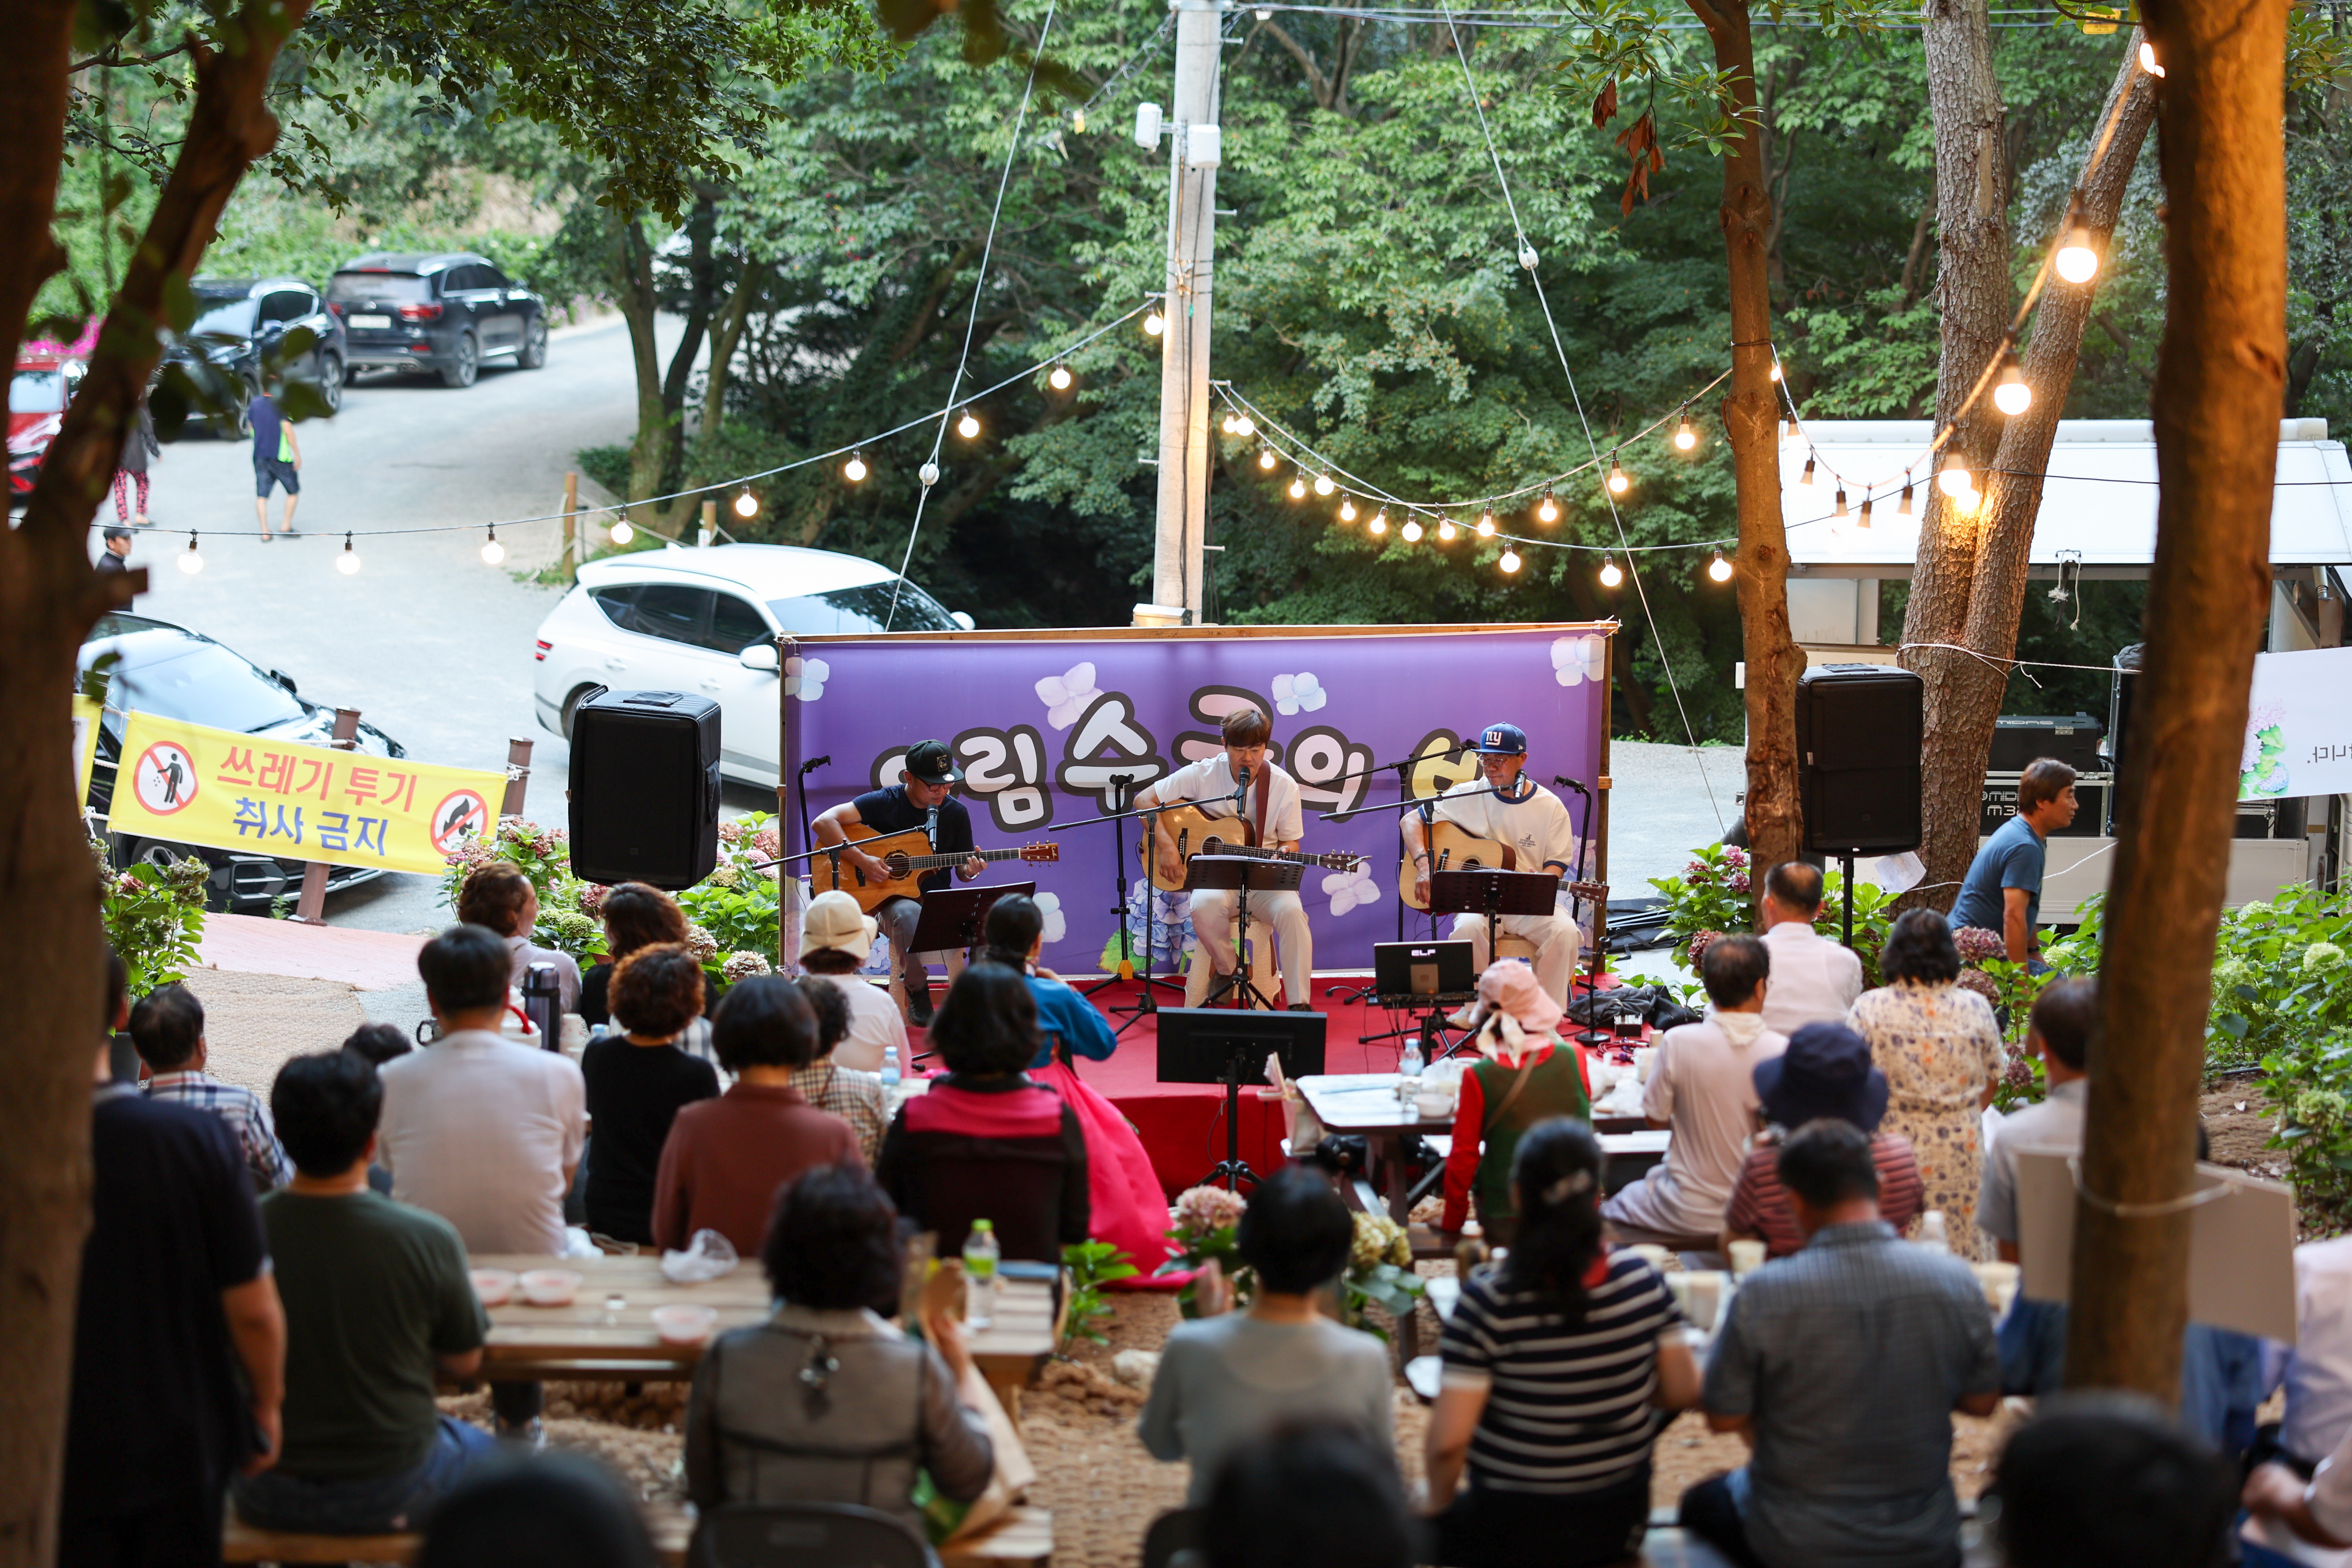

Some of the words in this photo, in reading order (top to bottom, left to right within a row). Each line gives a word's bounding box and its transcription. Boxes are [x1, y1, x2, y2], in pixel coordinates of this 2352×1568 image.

[218, 746, 334, 801] 쓰레기
[345, 767, 417, 812] 투기
[1989, 791, 2020, 801] MID
[233, 797, 304, 844] 취사
[317, 811, 388, 856] 금지
[1987, 805, 2020, 816] M3
